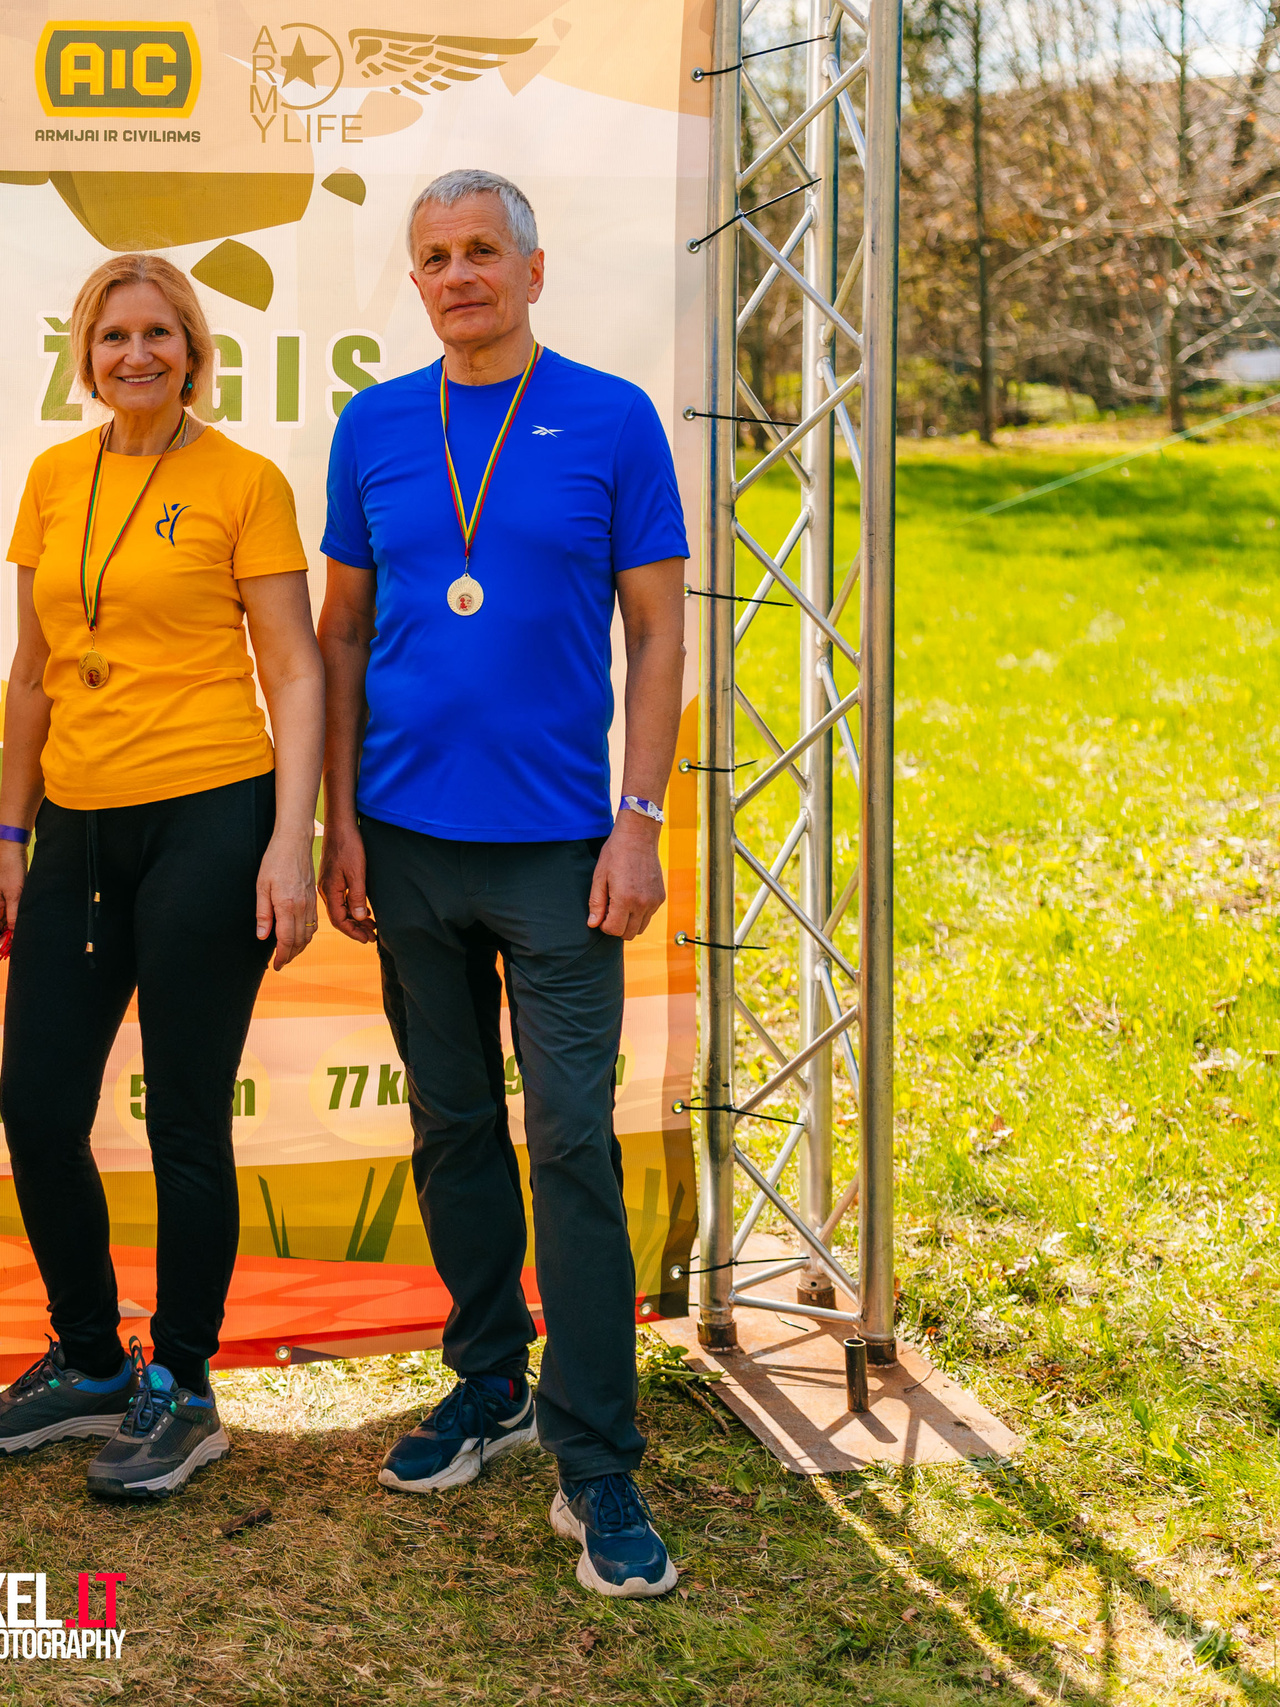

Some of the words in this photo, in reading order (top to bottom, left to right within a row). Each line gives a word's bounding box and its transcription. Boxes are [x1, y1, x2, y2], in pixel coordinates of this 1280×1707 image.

[60, 42, 177, 96] AIC
[35, 129, 99, 142] ARMIJAI
[104, 130, 118, 142] IR
[122, 130, 201, 142] CIVILIAMS
[327, 1065, 369, 1110] 77
[377, 1064, 409, 1106] k
